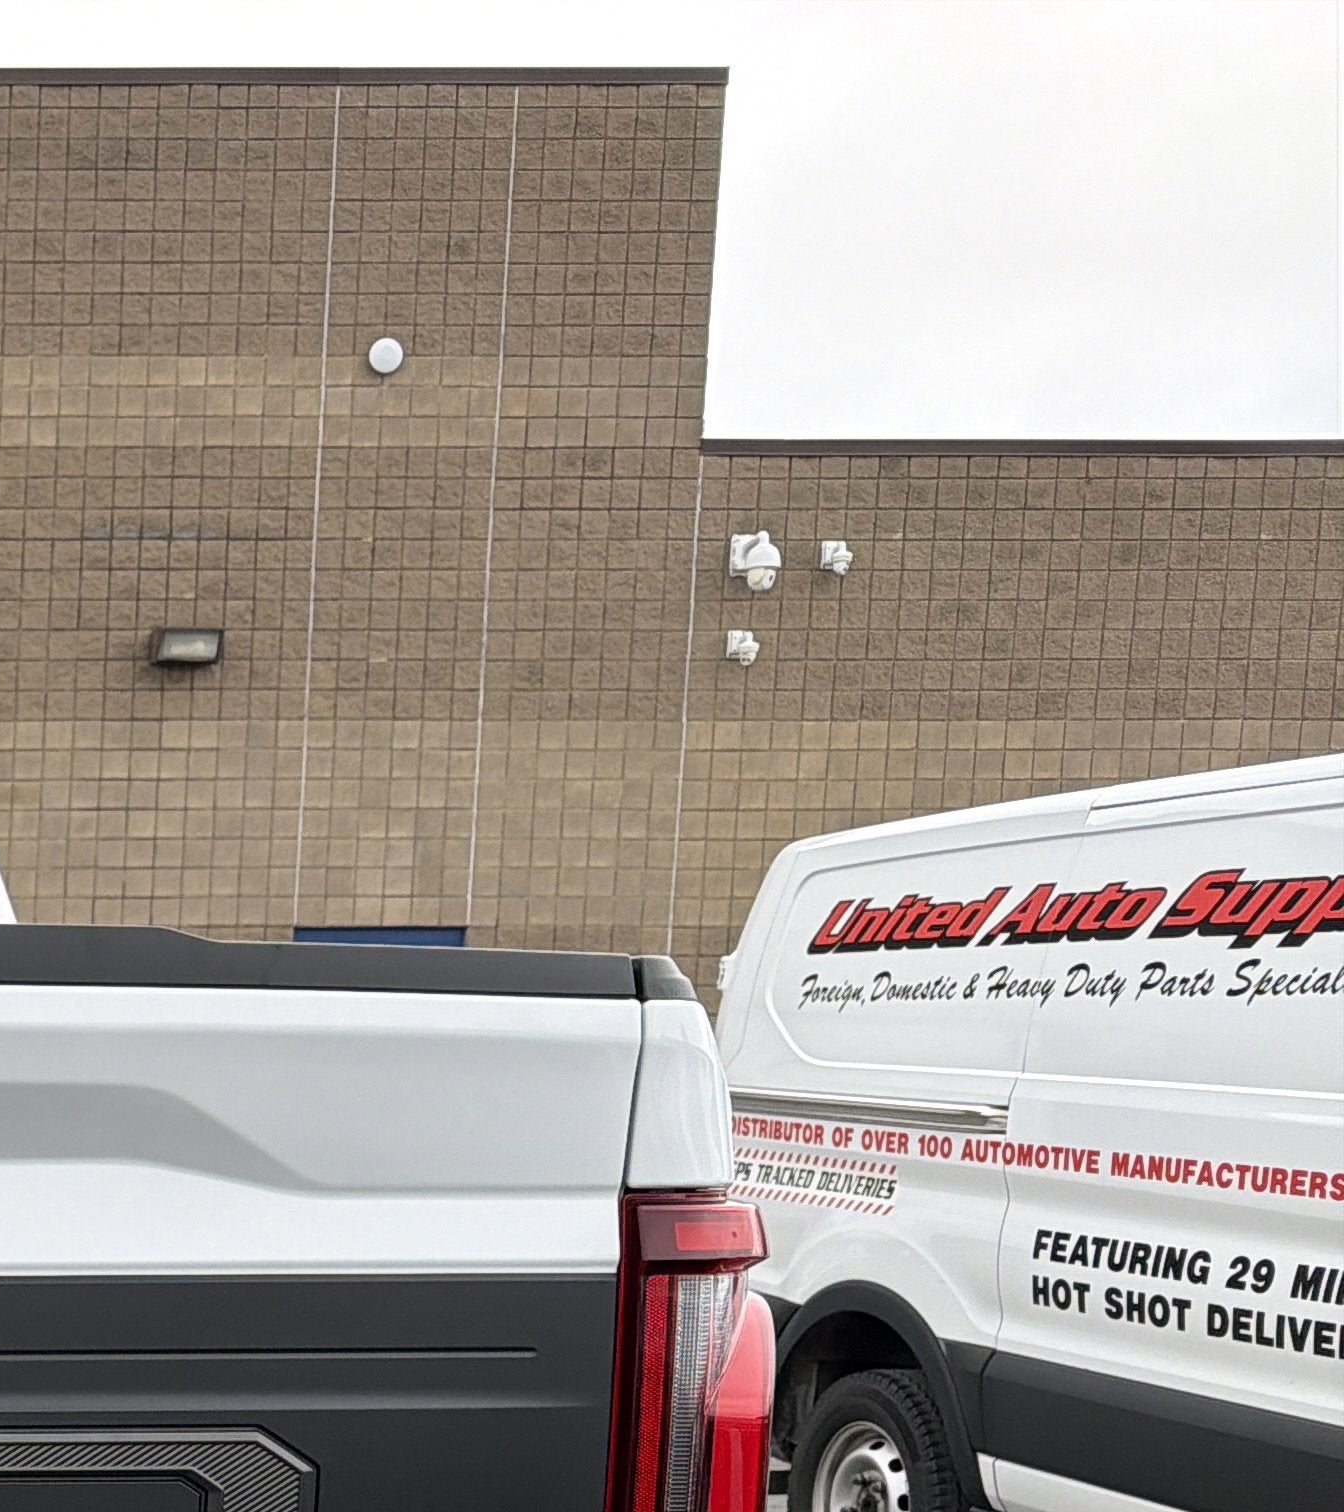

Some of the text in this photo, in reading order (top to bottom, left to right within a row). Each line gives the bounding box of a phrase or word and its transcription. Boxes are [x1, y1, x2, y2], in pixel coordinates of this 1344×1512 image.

[807, 886, 1012, 955] United
[975, 882, 1167, 947] Auto
[798, 974, 865, 1013] Foreign,
[870, 971, 957, 1001] Domestic
[962, 973, 980, 1000] &
[986, 966, 1057, 1008] Heavy
[1064, 963, 1127, 1007] Duty
[1135, 961, 1214, 1001] Parts
[733, 1160, 897, 1199] PS TRACKED DELIVERIES
[832, 1126, 854, 1148] OF
[861, 1129, 909, 1154] OVER
[918, 1134, 952, 1158] 100
[962, 1138, 1100, 1174] AUTOMOTIVE
[1110, 1151, 1344, 1201] MANUFACTURERS
[1032, 1229, 1344, 1305] FEATURING 29 MI
[1032, 1275, 1344, 1360] HOT SHOT DELIVE
